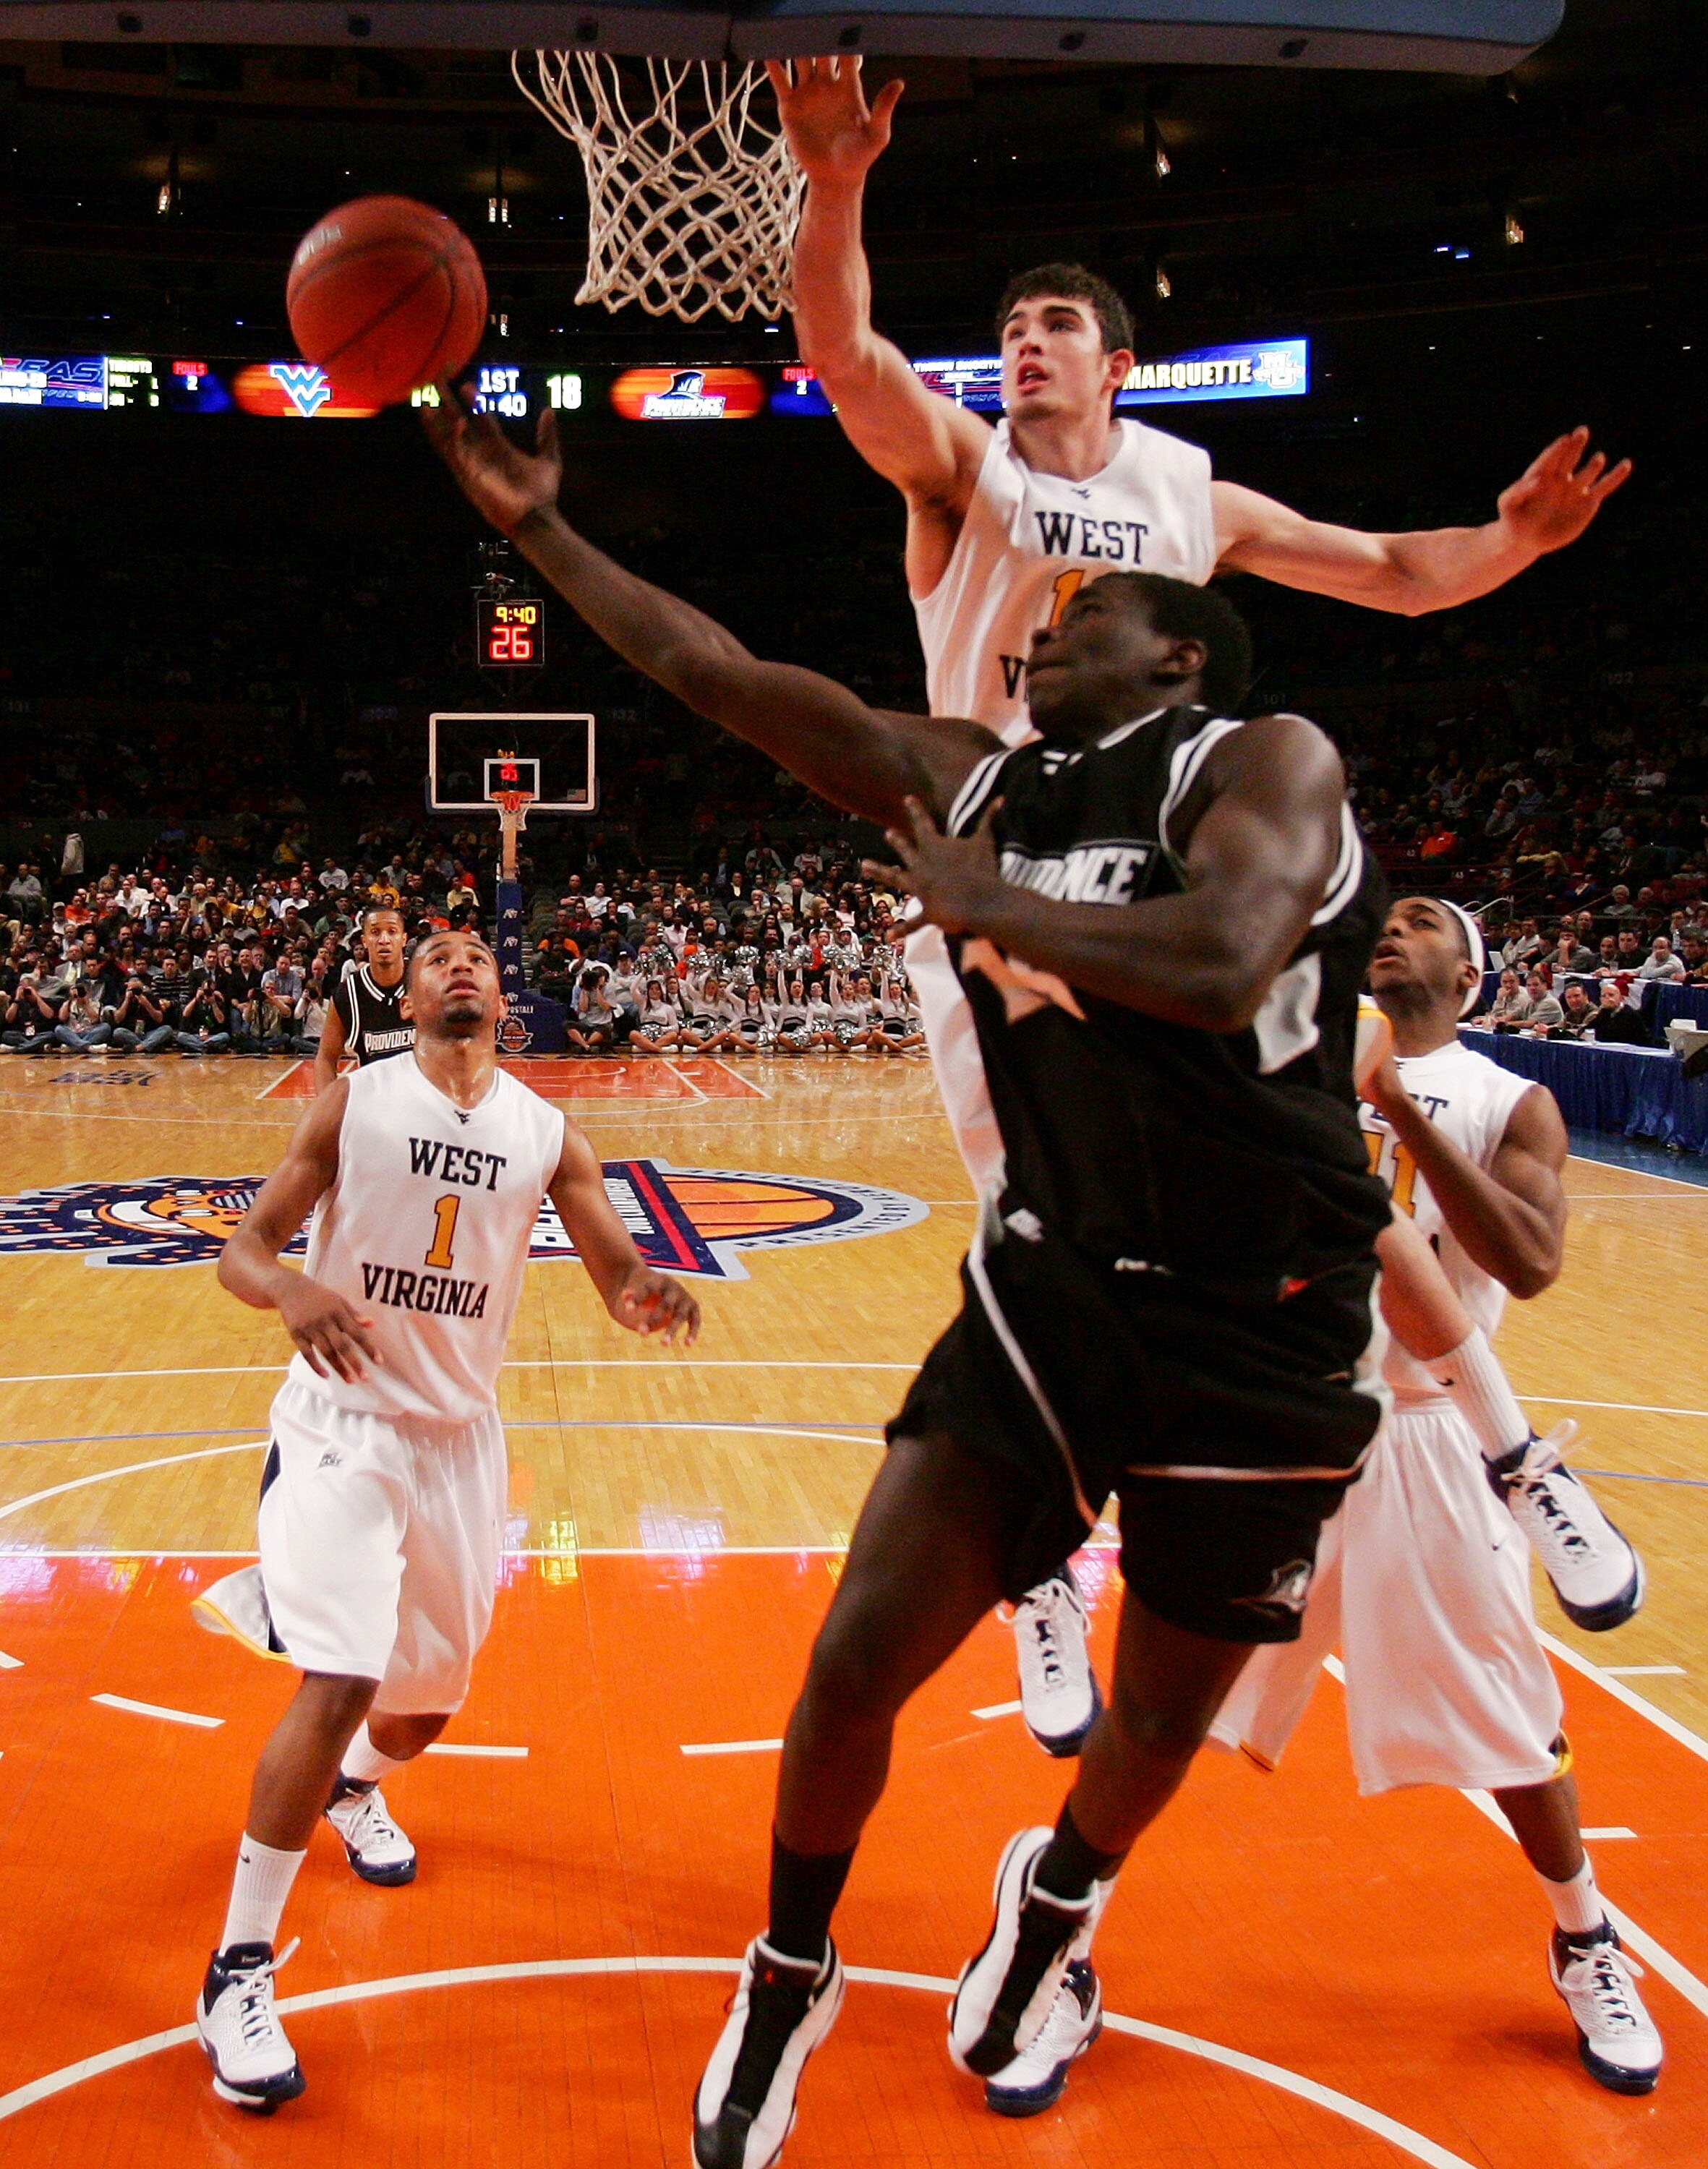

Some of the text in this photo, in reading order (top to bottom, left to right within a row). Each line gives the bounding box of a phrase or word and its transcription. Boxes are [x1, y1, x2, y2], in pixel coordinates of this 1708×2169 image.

[175, 363, 205, 375] FOULS
[187, 375, 197, 390] 2
[480, 370, 519, 393] 1ST
[784, 368, 814, 381] FOULS
[1122, 359, 1252, 390] MARQUETTE
[547, 375, 581, 409] 18
[796, 380, 807, 395] 2
[1036, 510, 1148, 565] WEST
[496, 607, 537, 625] 9:40
[492, 626, 531, 659] 26
[364, 1028, 417, 1053] PROVIDEN
[409, 1137, 507, 1192] WEST
[424, 1194, 461, 1270] 1
[362, 1263, 490, 1319] VIRGINIA
